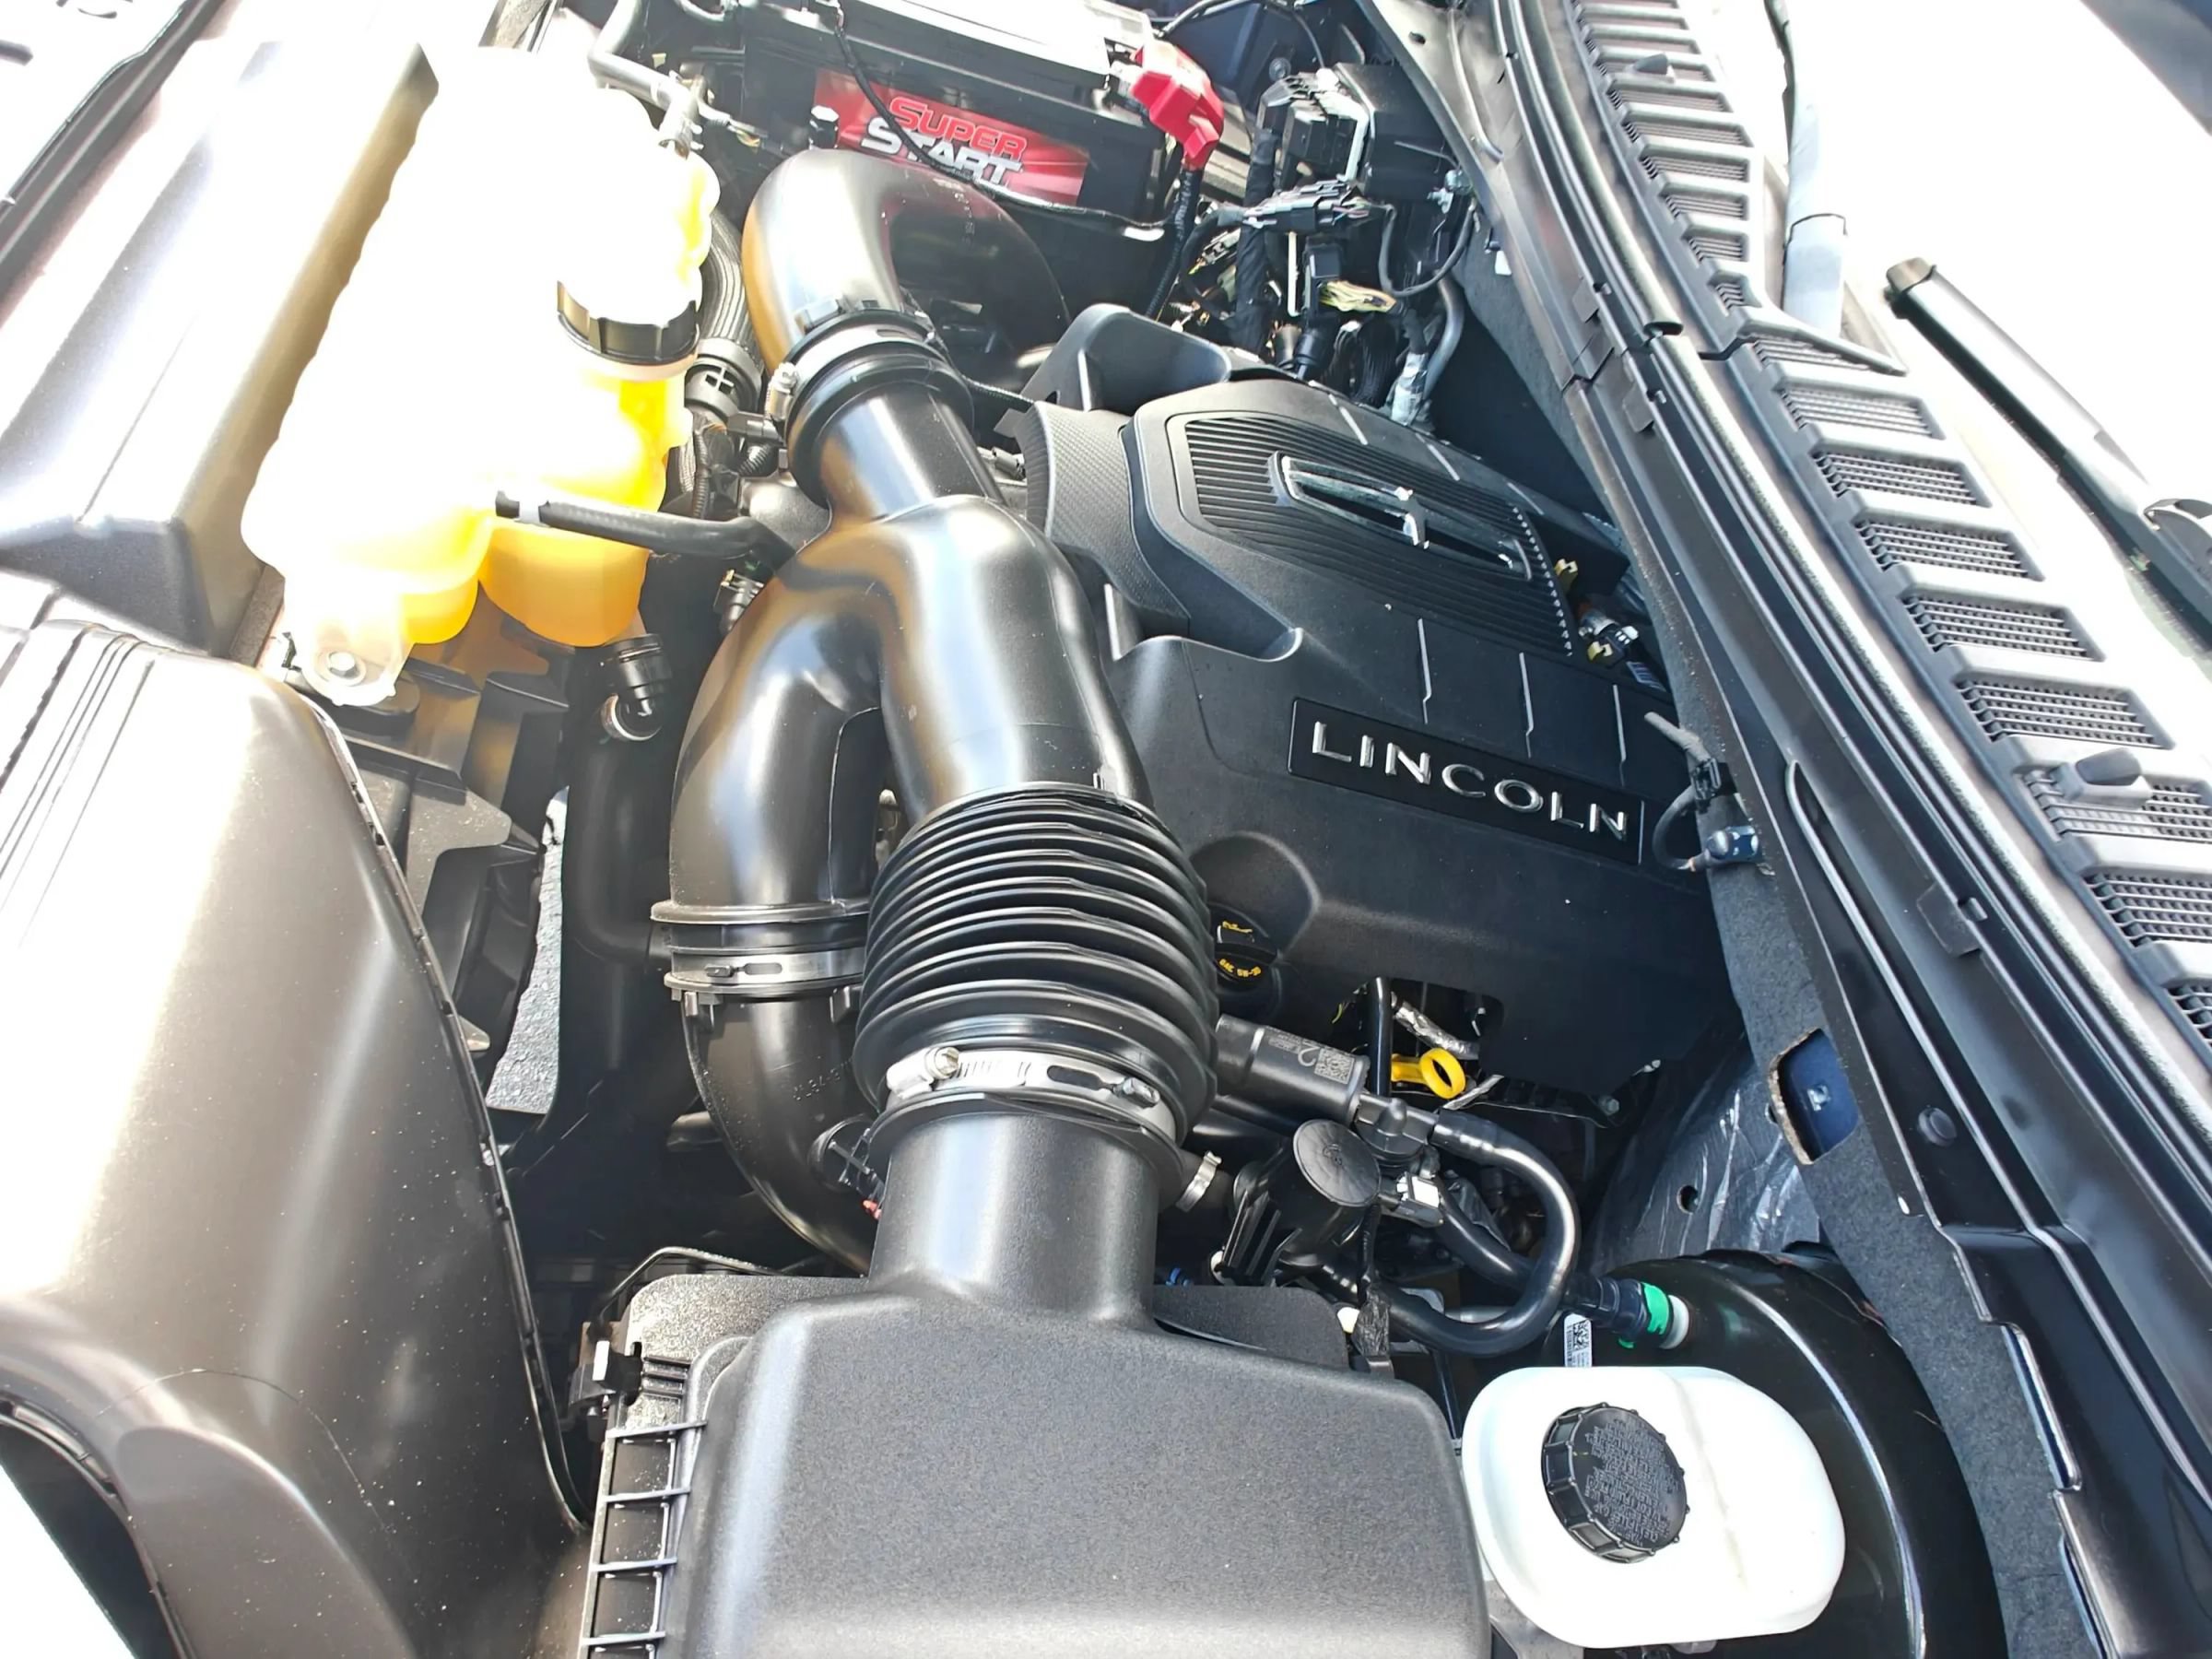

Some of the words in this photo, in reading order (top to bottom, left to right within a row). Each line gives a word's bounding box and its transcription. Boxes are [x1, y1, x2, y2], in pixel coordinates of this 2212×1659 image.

[861, 116, 1023, 184] START
[889, 96, 1028, 162] SUPER
[1312, 721, 1627, 841] LINCOLN
